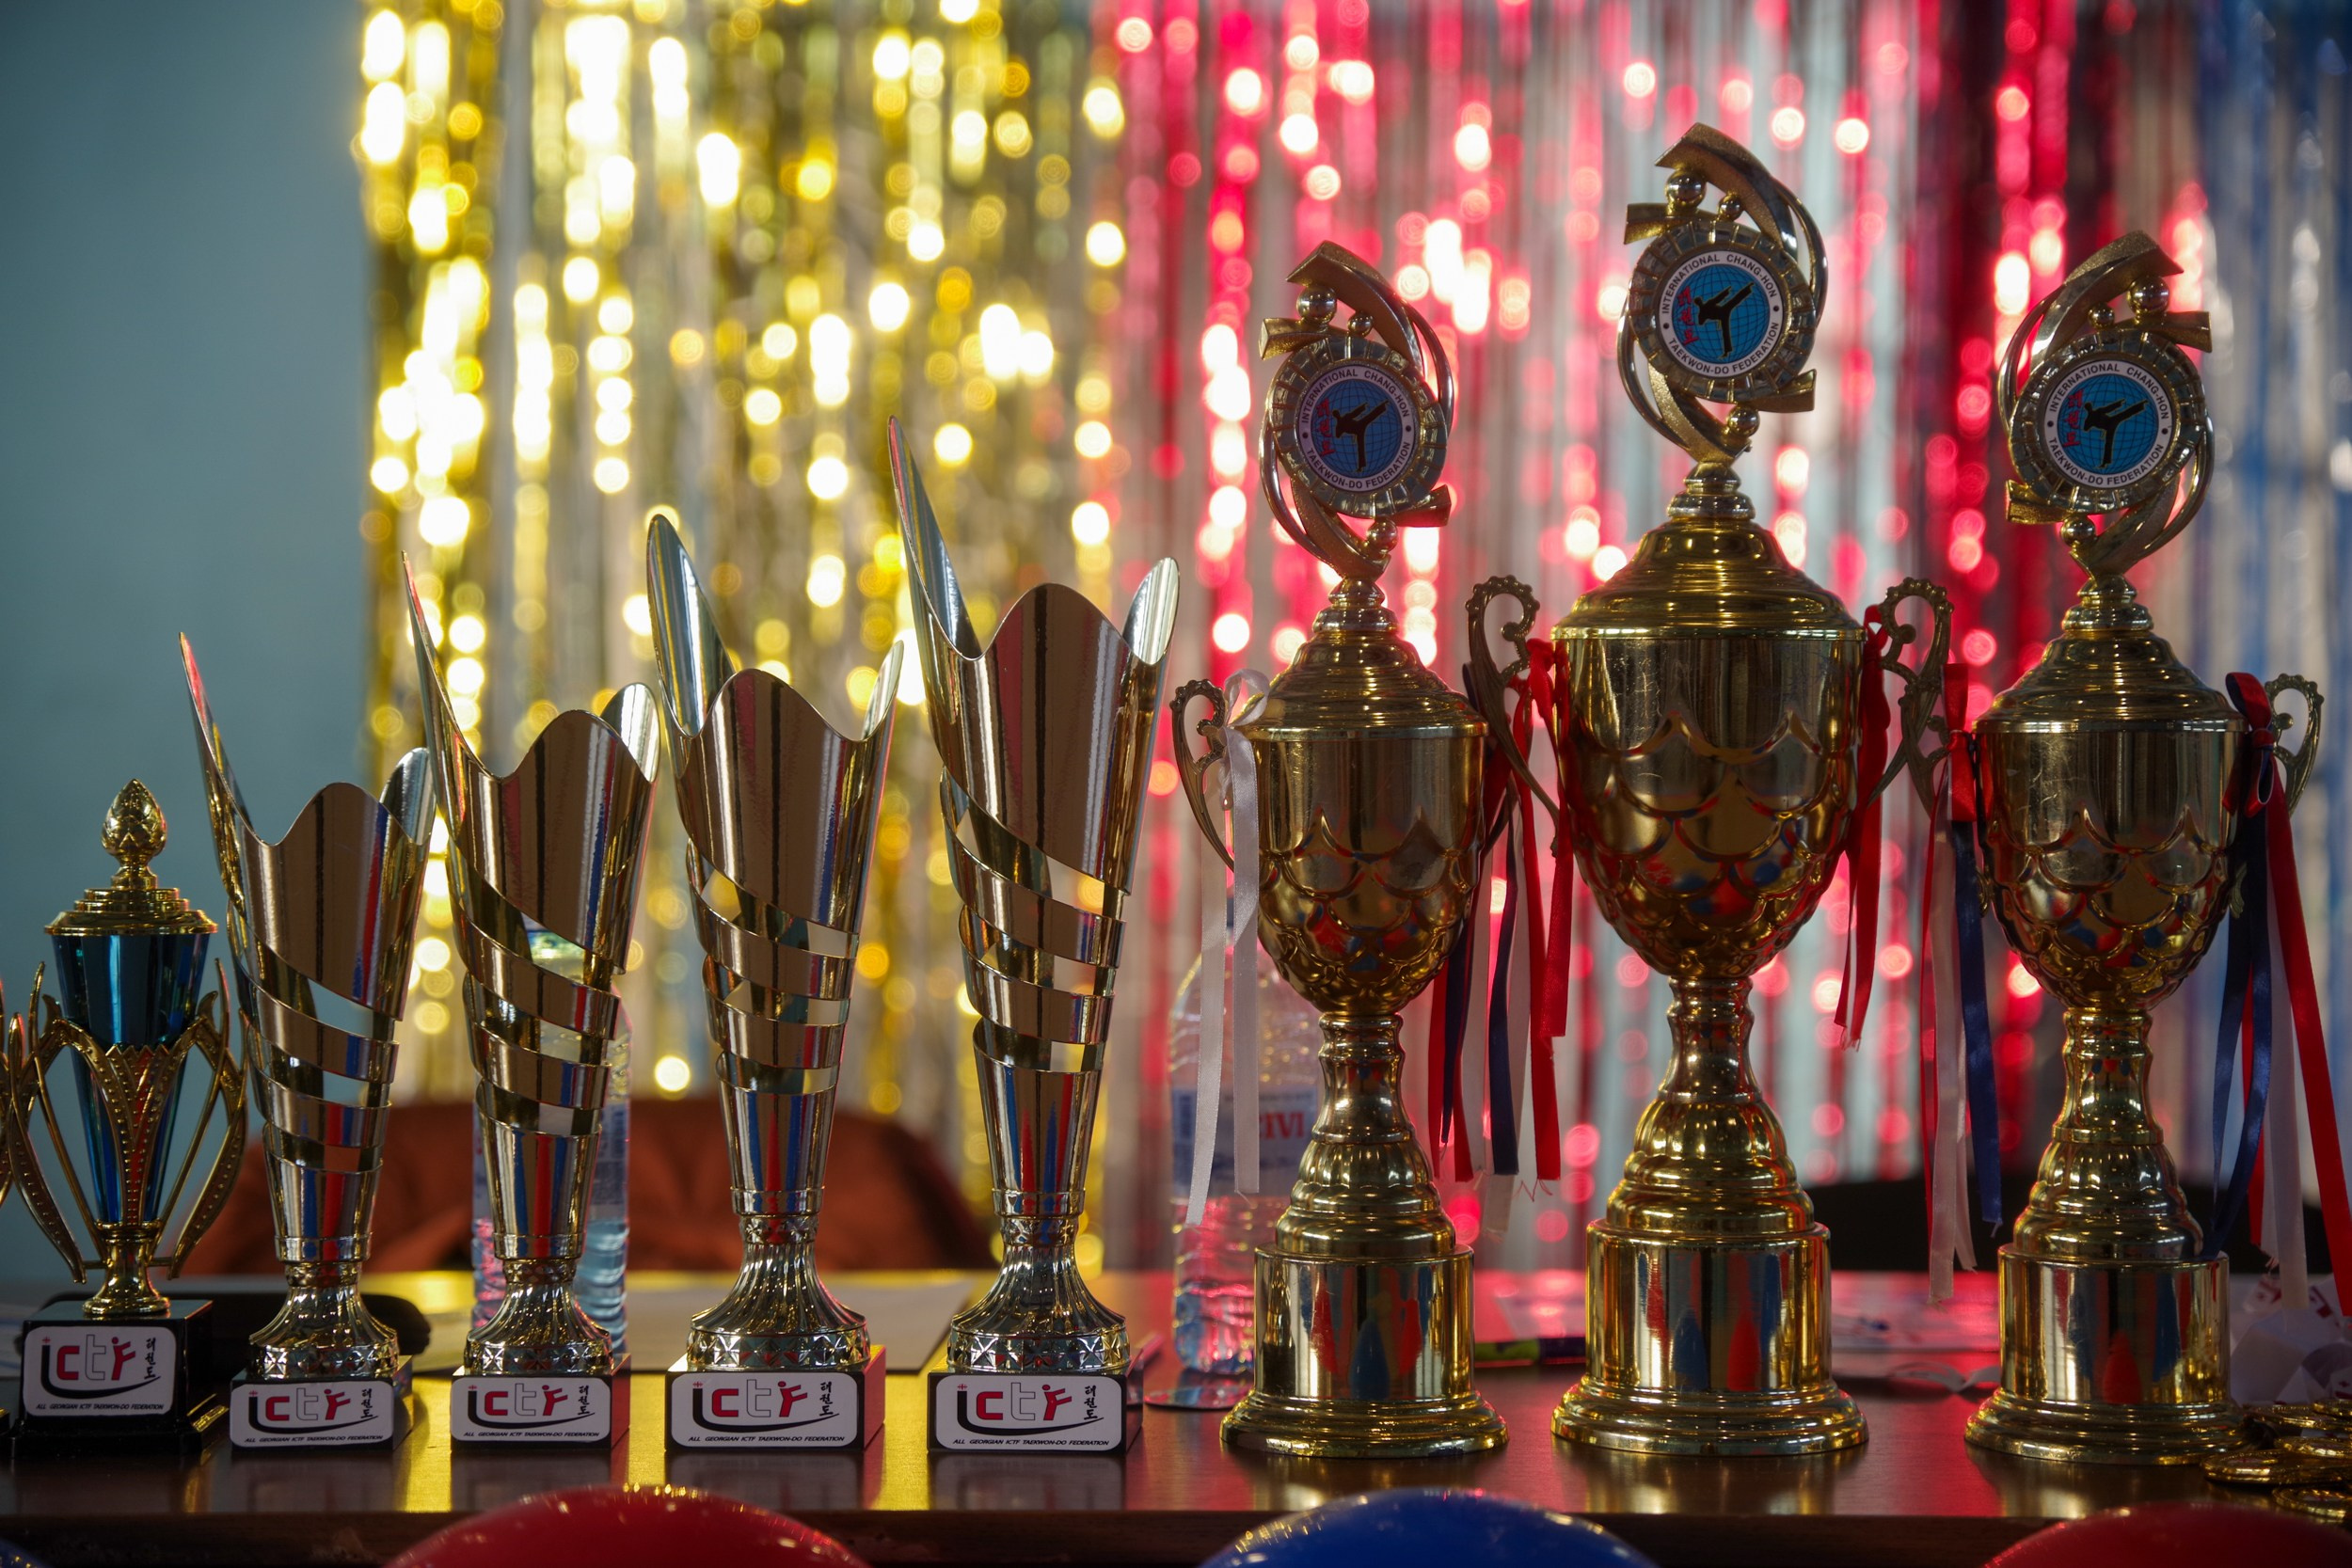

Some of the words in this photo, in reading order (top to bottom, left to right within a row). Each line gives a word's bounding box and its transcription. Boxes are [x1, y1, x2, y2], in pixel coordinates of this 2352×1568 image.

[1662, 255, 1720, 313] INTERNATIONAL
[1727, 255, 1777, 297] CHANG-HON
[1669, 338, 1729, 374] TAEKWON-DO
[1733, 323, 1779, 372] FEDERATION
[1302, 369, 1358, 423] INTERNATIONAL
[1365, 371, 1410, 417] CHANG-HON
[2050, 363, 2120, 412] INTERNATIONAL
[2127, 368, 2169, 420] CHANG-HON
[1307, 448, 1362, 488] TAEKWON-DO
[1366, 442, 1410, 488] FEDERATION
[2049, 437, 2104, 484] TAEKWON-DO
[2107, 444, 2163, 484] FEDERATION
